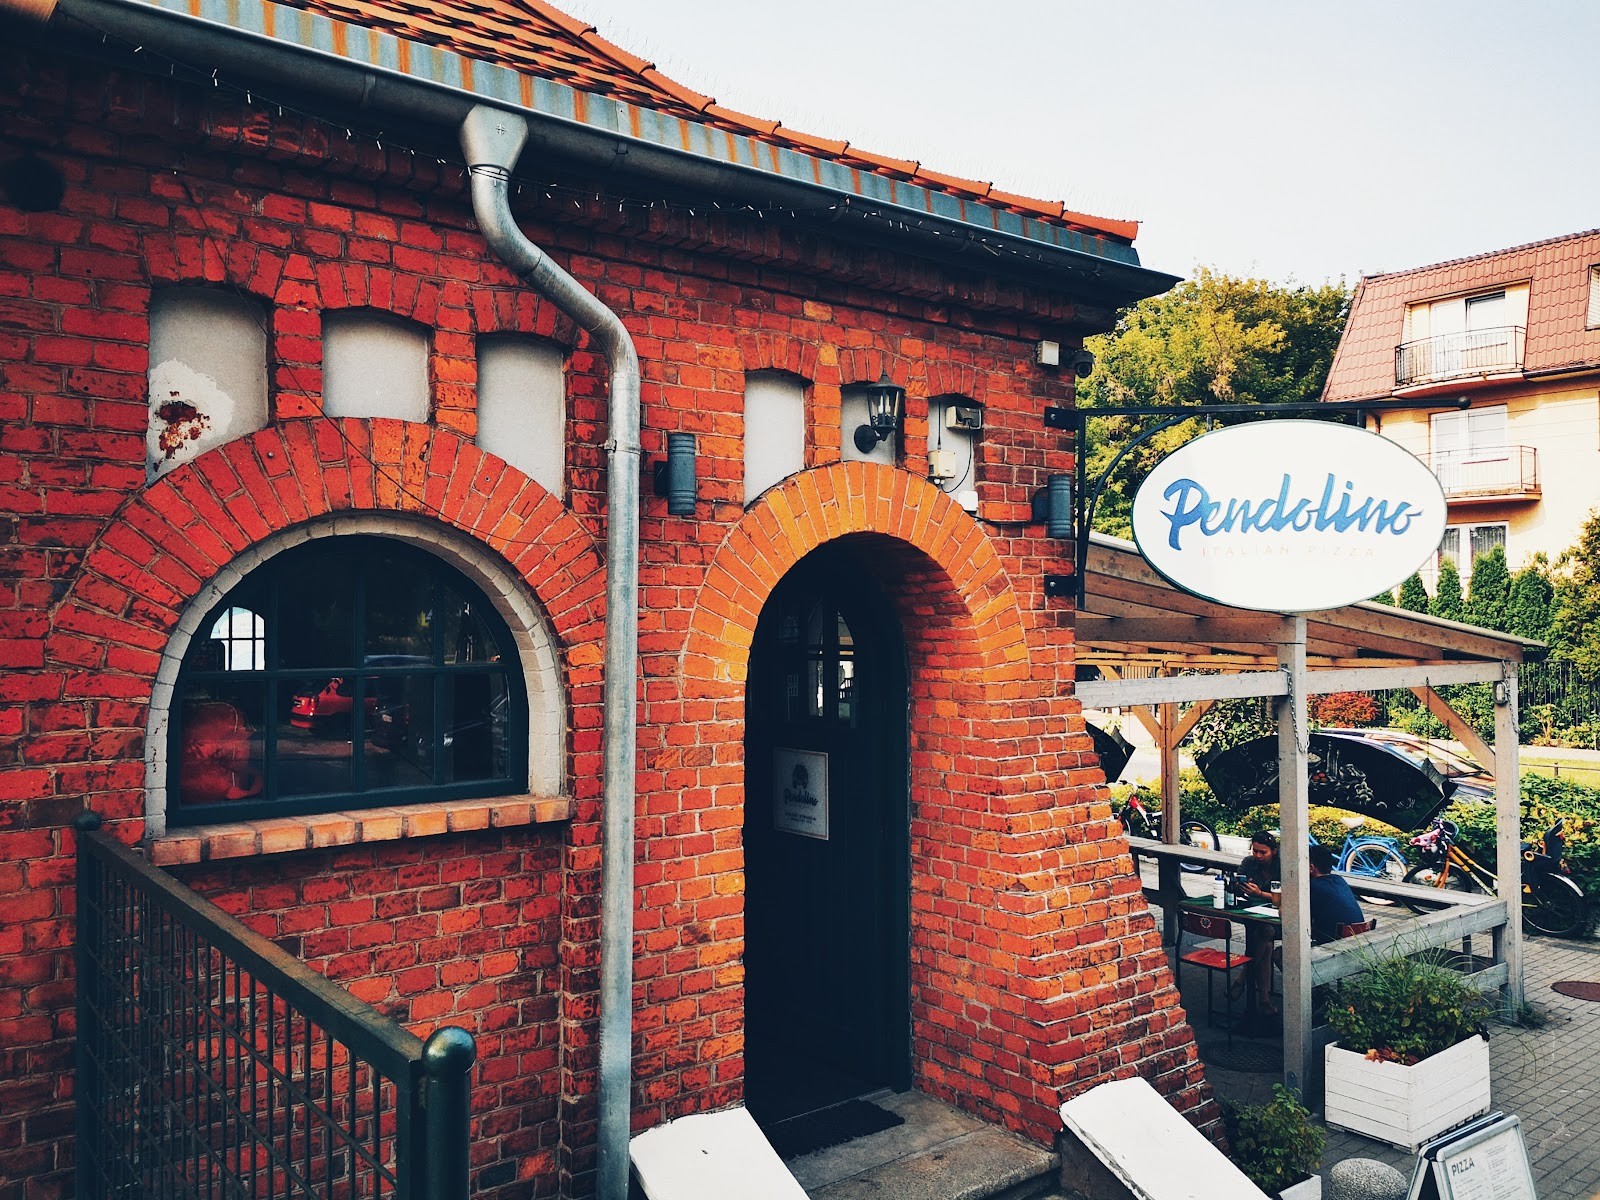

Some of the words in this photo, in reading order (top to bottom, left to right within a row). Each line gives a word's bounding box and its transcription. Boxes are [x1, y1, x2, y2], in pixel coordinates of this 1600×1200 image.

[1160, 473, 1424, 551] Pendolino
[1202, 544, 1289, 558] ITALIAN
[1307, 544, 1375, 558] PIZZA
[1451, 1156, 1476, 1177] PIZZA
